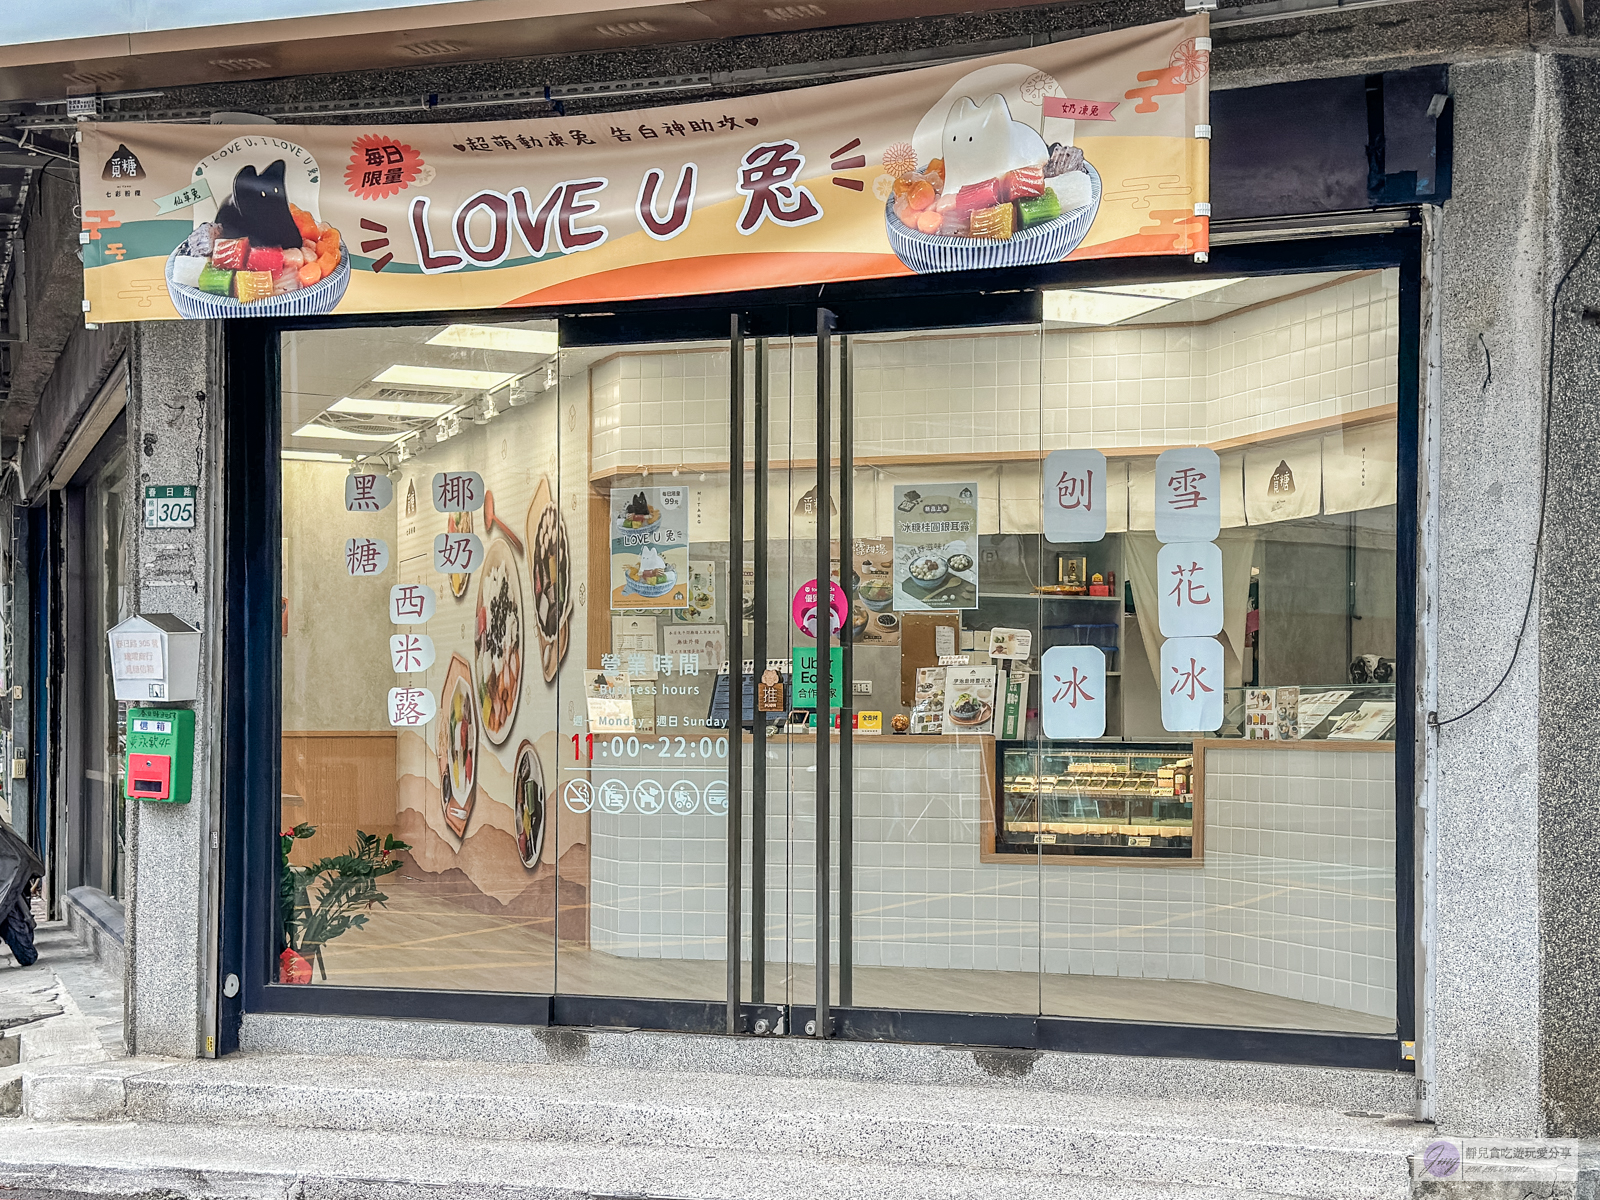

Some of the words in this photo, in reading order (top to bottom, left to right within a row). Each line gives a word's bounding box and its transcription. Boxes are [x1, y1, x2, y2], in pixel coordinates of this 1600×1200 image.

[610, 114, 745, 143] 告白神助攻
[211, 142, 241, 161] LOVE
[272, 138, 303, 158] LOVE
[364, 145, 404, 167] 每日
[111, 156, 137, 179] 覓糖
[361, 167, 404, 188] 限量
[408, 178, 608, 275] LOVE
[635, 161, 698, 241] U
[736, 139, 823, 236] 兔
[158, 503, 193, 522] 305
[437, 472, 474, 570] 椰奶
[346, 474, 382, 576] 黑糖
[901, 521, 970, 533] 冰糖桂圓銀耳露
[623, 533, 650, 547] LOVE
[653, 532, 661, 543] U
[1167, 467, 1215, 702] 雪花冰
[392, 585, 427, 725] 西米露
[601, 652, 700, 677] 營業時間
[801, 656, 834, 670] Ubr
[801, 671, 834, 684] Eas
[599, 684, 658, 695] Business
[662, 683, 700, 695] hours
[762, 686, 778, 703] 推
[797, 687, 837, 699] 合作家
[140, 721, 165, 731] 信箱
[598, 716, 645, 728] Monday
[656, 715, 678, 728] 週日
[683, 715, 728, 729] Sunday
